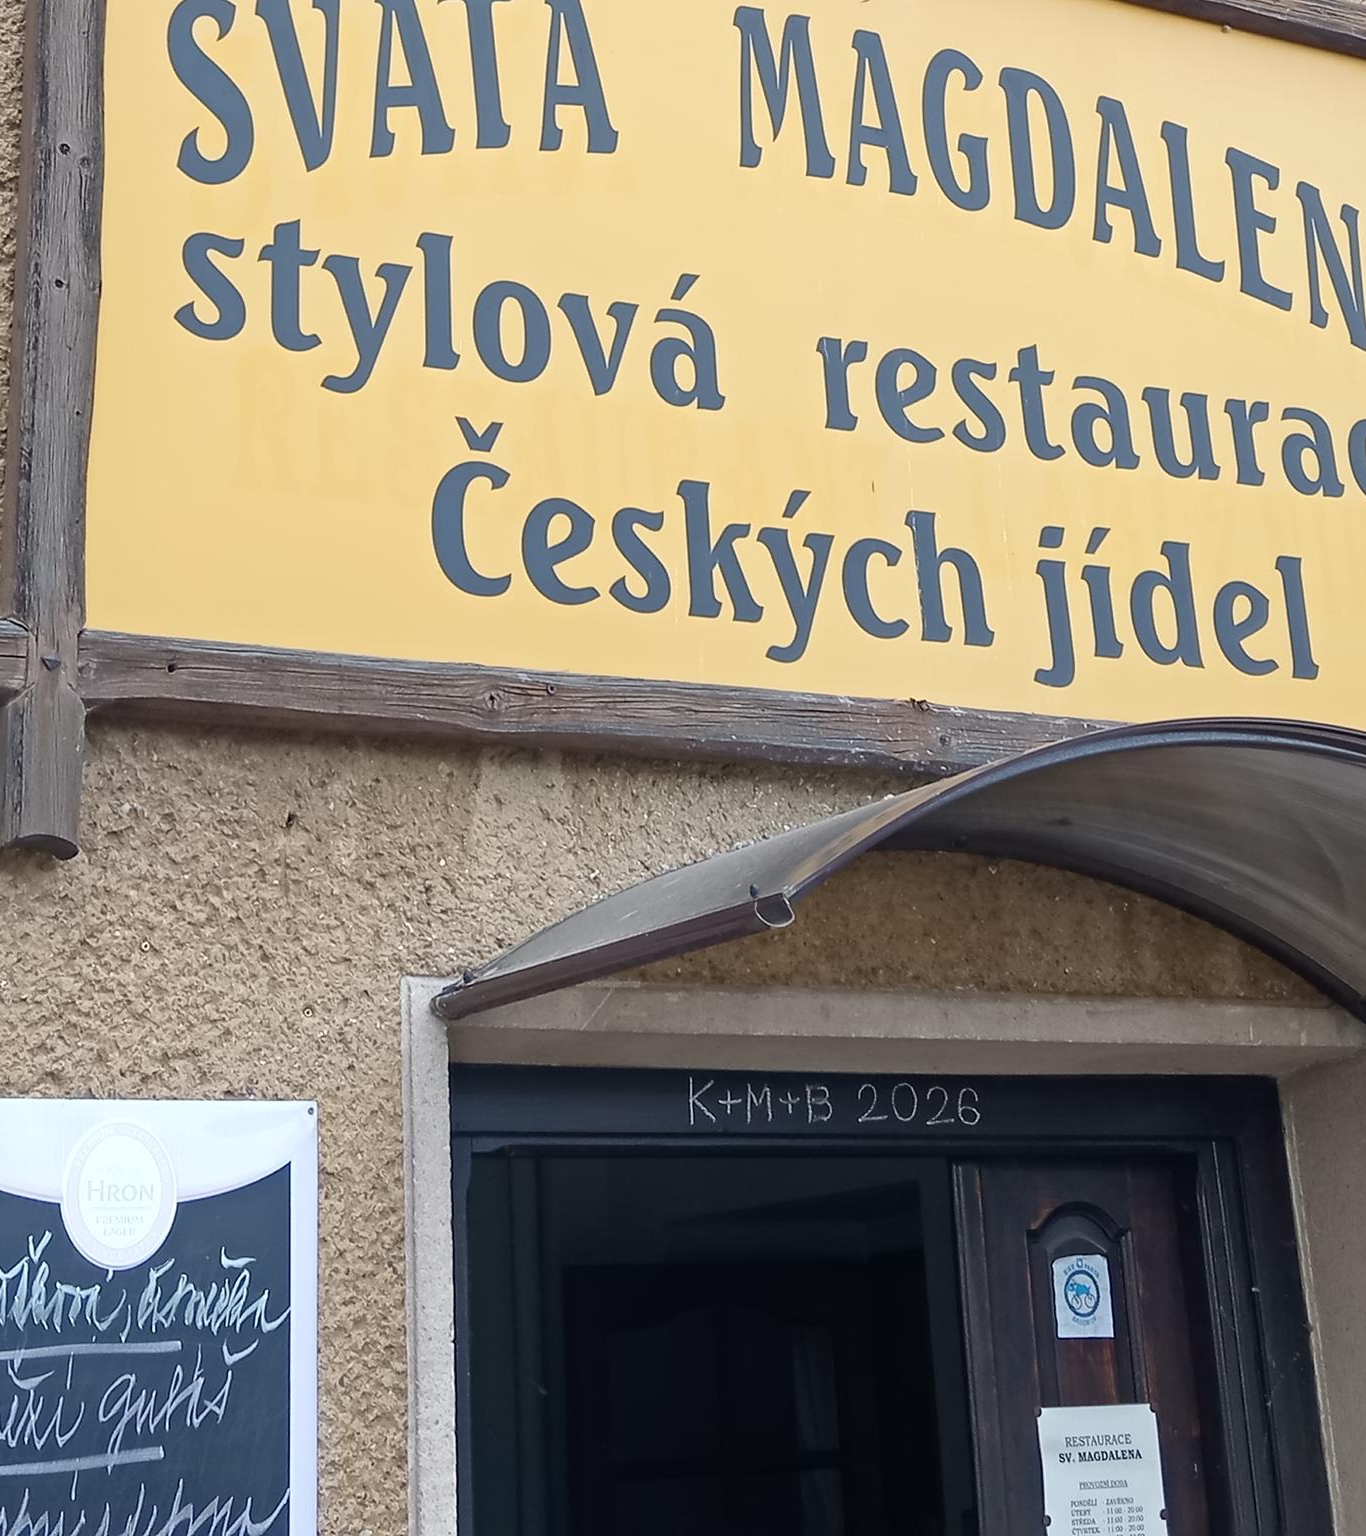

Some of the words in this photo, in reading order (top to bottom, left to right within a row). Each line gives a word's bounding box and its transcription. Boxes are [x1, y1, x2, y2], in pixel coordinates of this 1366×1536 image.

[173, 219, 726, 411] stylová
[431, 416, 995, 664] Českých
[1034, 525, 1321, 689] jídel
[858, 1082, 981, 1125] 2026
[1059, 1452, 1075, 1463] SV.
[1078, 1449, 1142, 1463] MAGDALENA
[1065, 1433, 1132, 1447] RESTAURACE
